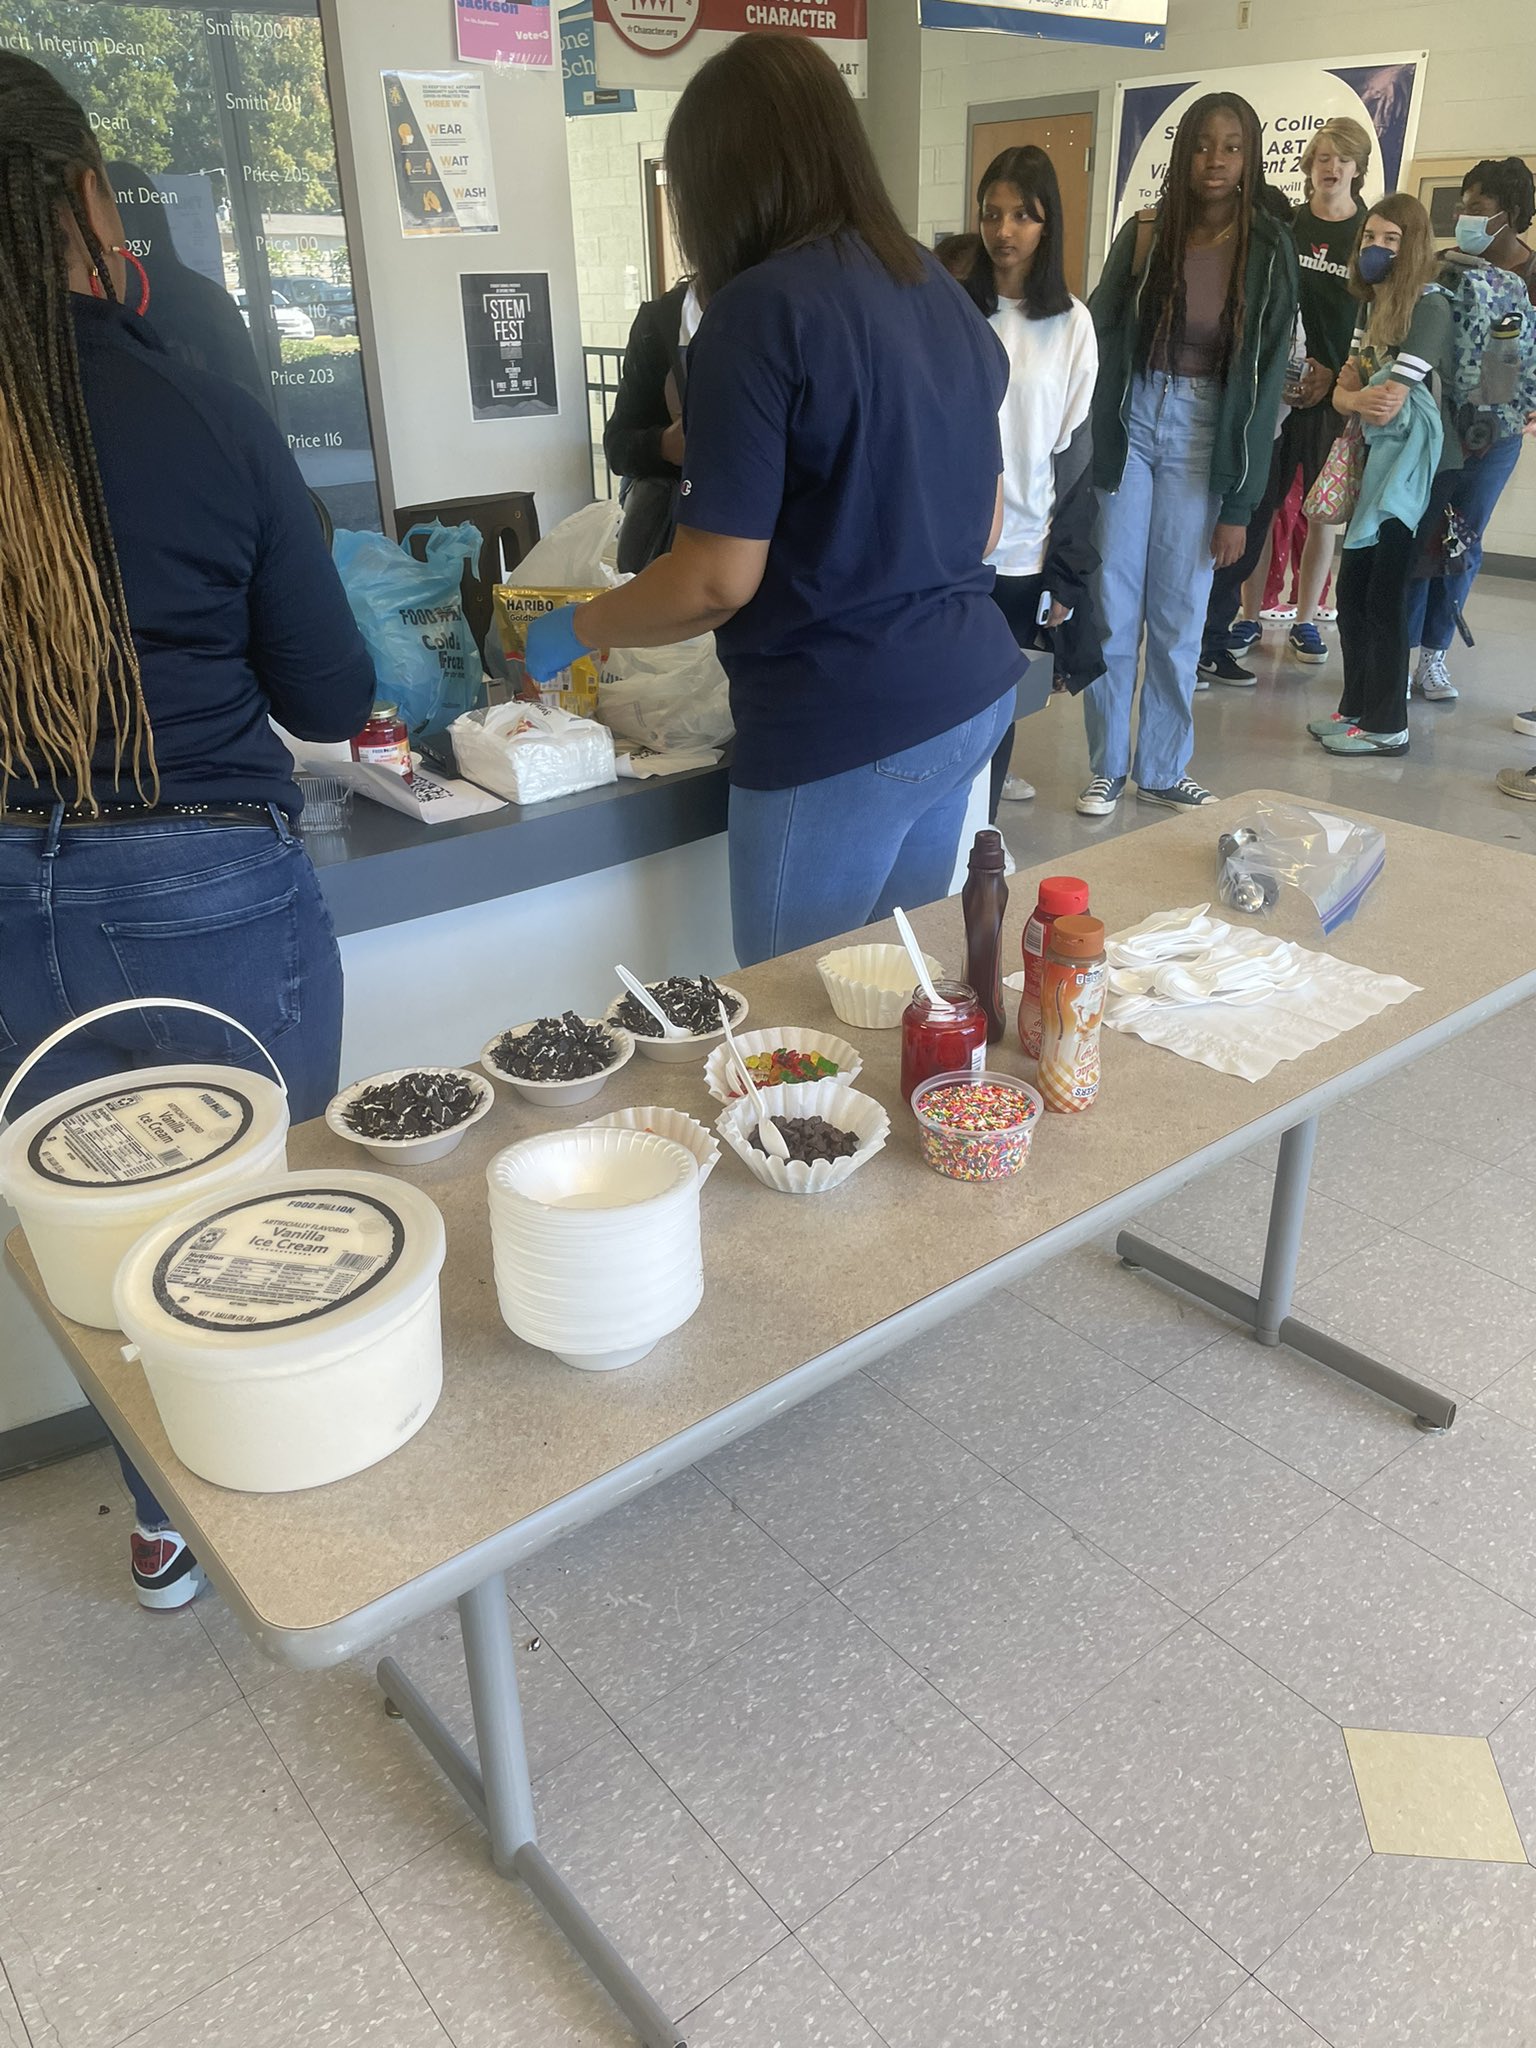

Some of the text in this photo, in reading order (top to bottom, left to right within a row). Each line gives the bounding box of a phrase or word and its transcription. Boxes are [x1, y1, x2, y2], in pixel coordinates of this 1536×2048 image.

[746, 5, 836, 29] CHARACTER
[205, 18, 293, 40] Smith 2004
[36, 31, 100, 53] Interim
[103, 37, 145, 56] Dean
[225, 92, 269, 111] Smith
[88, 112, 131, 130] Dean
[427, 123, 462, 135] WEAR
[1275, 115, 1333, 131] Colle
[1266, 139, 1307, 156] A&T
[440, 155, 469, 167] WAIT
[243, 165, 310, 183] Price 205
[138, 187, 178, 204] Dean
[453, 187, 487, 199] WASH
[1139, 188, 1152, 198] To
[256, 236, 318, 251] Price 100
[489, 298, 526, 319] STEM
[493, 320, 524, 341] FEST
[271, 368, 334, 385] Price 203
[287, 432, 342, 449] Price 116
[506, 599, 554, 612] HARIBO
[138, 1112, 174, 1144] Ice Cream
[158, 1110, 186, 1134] Vanilla
[287, 1200, 316, 1209] FOOD
[262, 1219, 350, 1234] ARTIFICIALLY FLAVORED
[272, 1226, 325, 1242] Vanilla
[249, 1235, 329, 1254] Ice Cream
